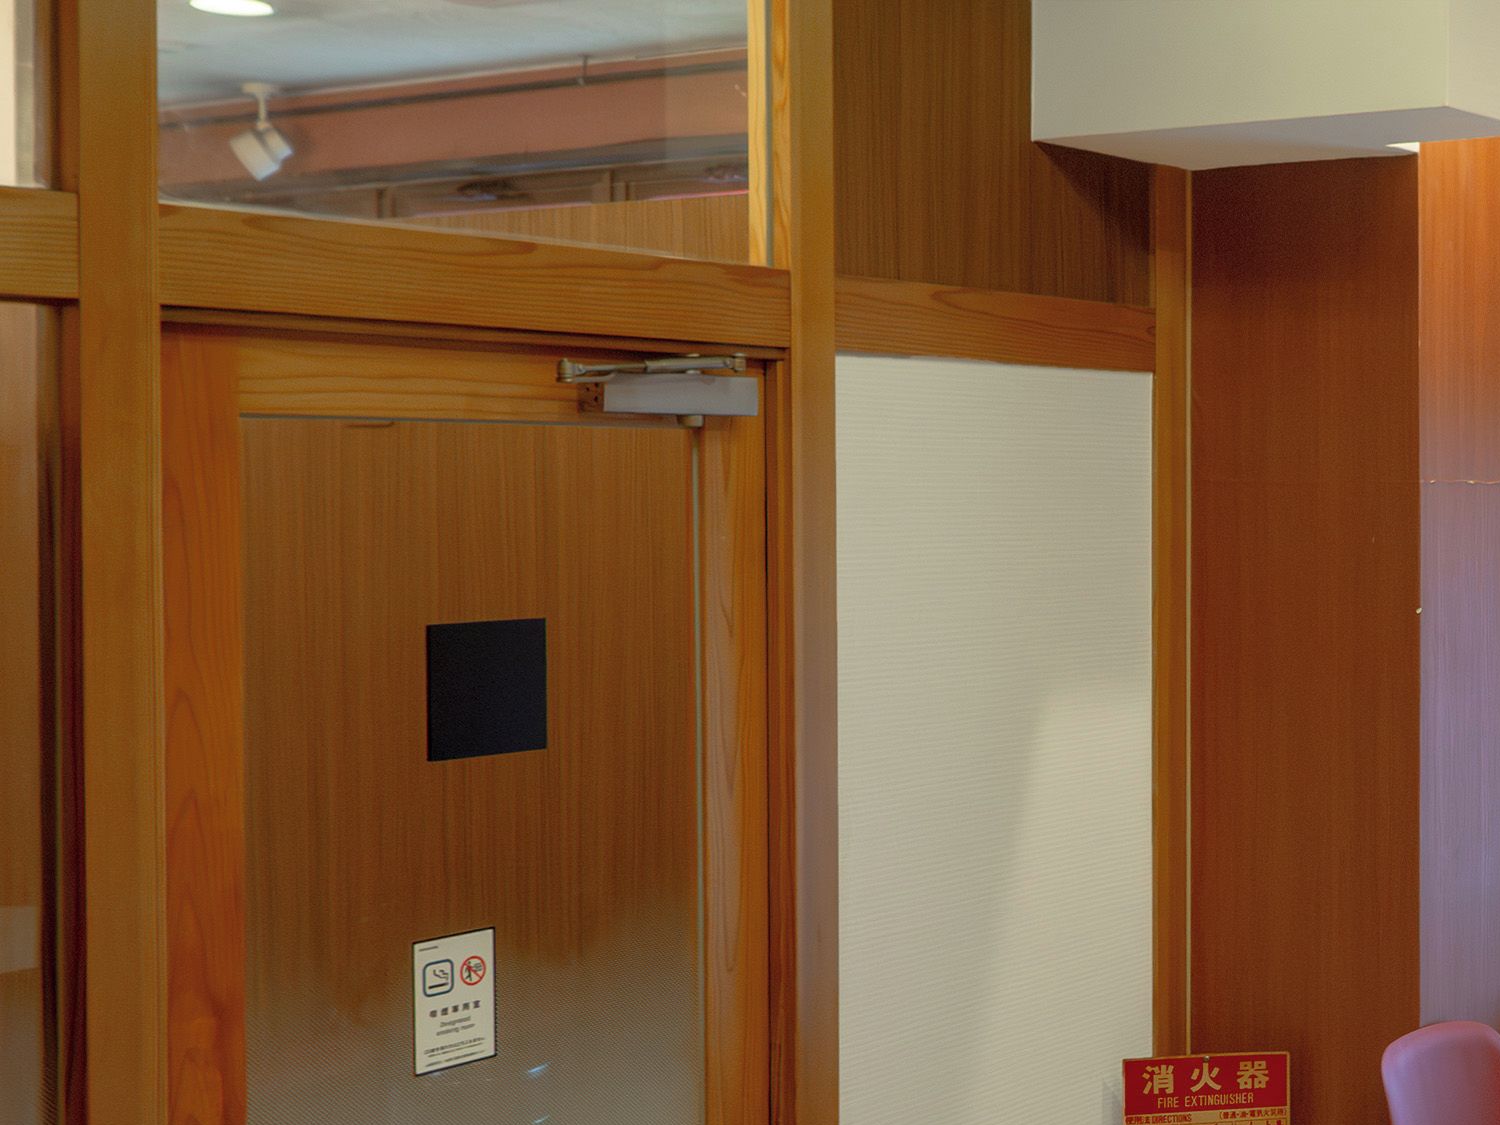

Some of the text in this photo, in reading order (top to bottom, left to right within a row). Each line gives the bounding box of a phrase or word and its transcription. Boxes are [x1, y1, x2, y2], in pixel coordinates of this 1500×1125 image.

[1142, 1061, 1270, 1095] 消火器
[1157, 1093, 1254, 1109] FIRE EXTINGUISHER
